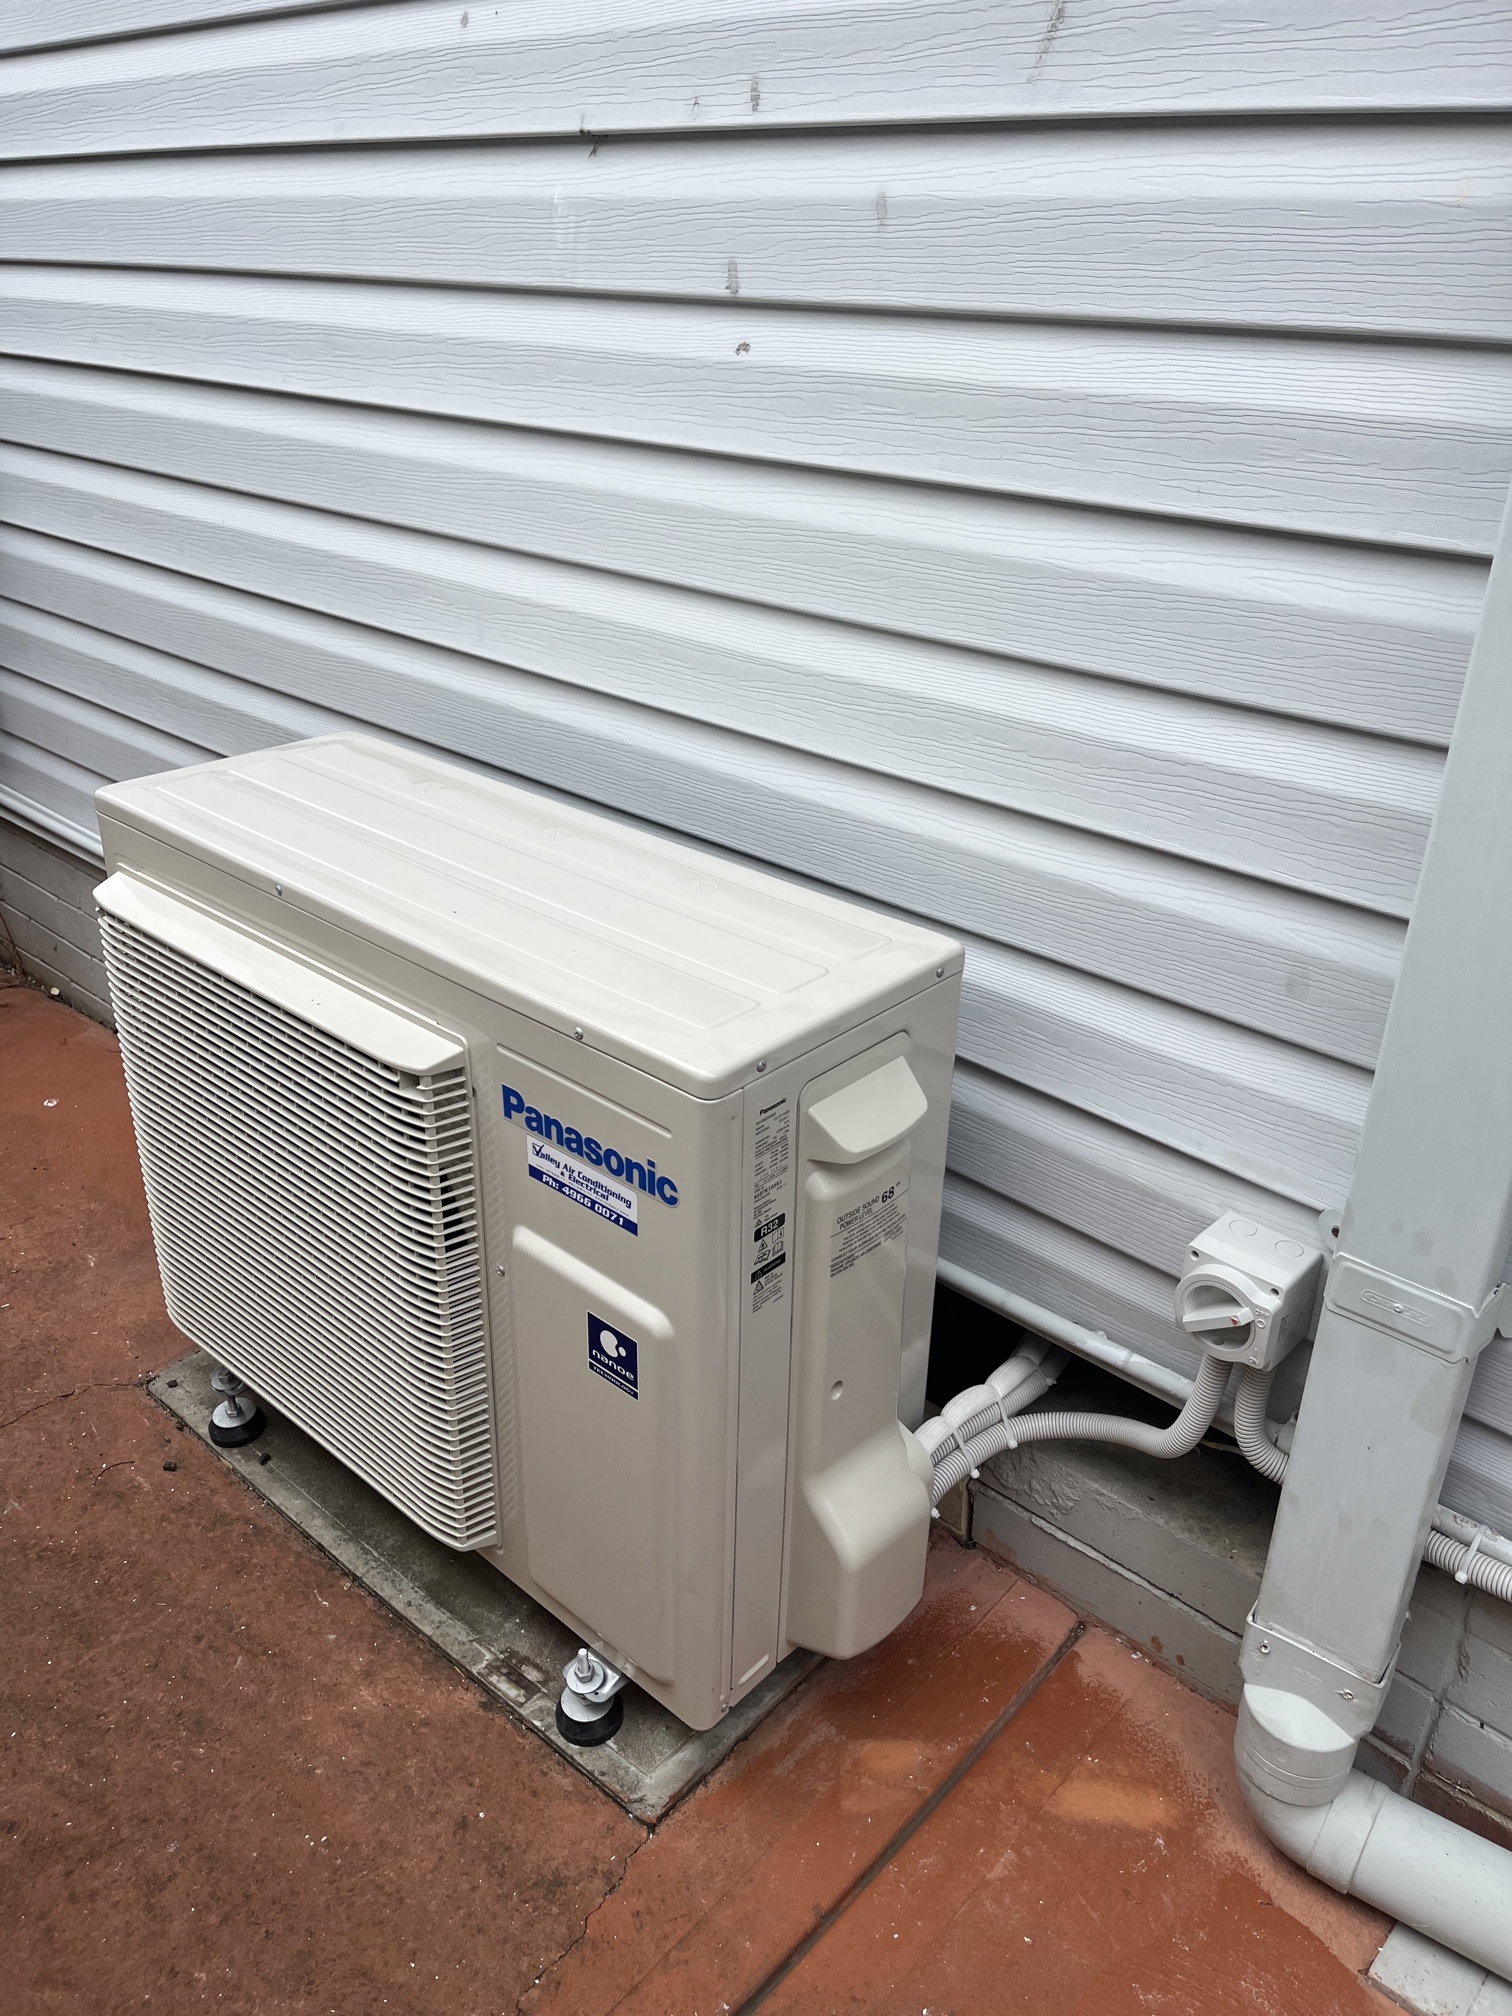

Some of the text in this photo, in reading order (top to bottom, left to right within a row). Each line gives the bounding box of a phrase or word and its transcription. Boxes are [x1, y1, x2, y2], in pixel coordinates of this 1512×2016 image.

[501, 1084, 679, 1207] Panasonic
[532, 1143, 561, 1169] Valley
[563, 1163, 576, 1175] Air
[577, 1171, 632, 1210] Conditioning
[568, 1173, 609, 1202] Electrical
[542, 1174, 560, 1190] Ph:
[561, 1185, 592, 1207] 4966
[594, 1203, 624, 1226] 0071
[881, 1186, 895, 1203] 68
[836, 1206, 861, 1225] OUTSIDE
[861, 1195, 880, 1212] SOUND
[839, 1216, 859, 1231] POWER
[858, 1207, 873, 1220] LEVEL
[760, 1219, 779, 1237] R32
[592, 1349, 635, 1382] nanoe
[593, 1365, 635, 1395] TECHNOLOGY
